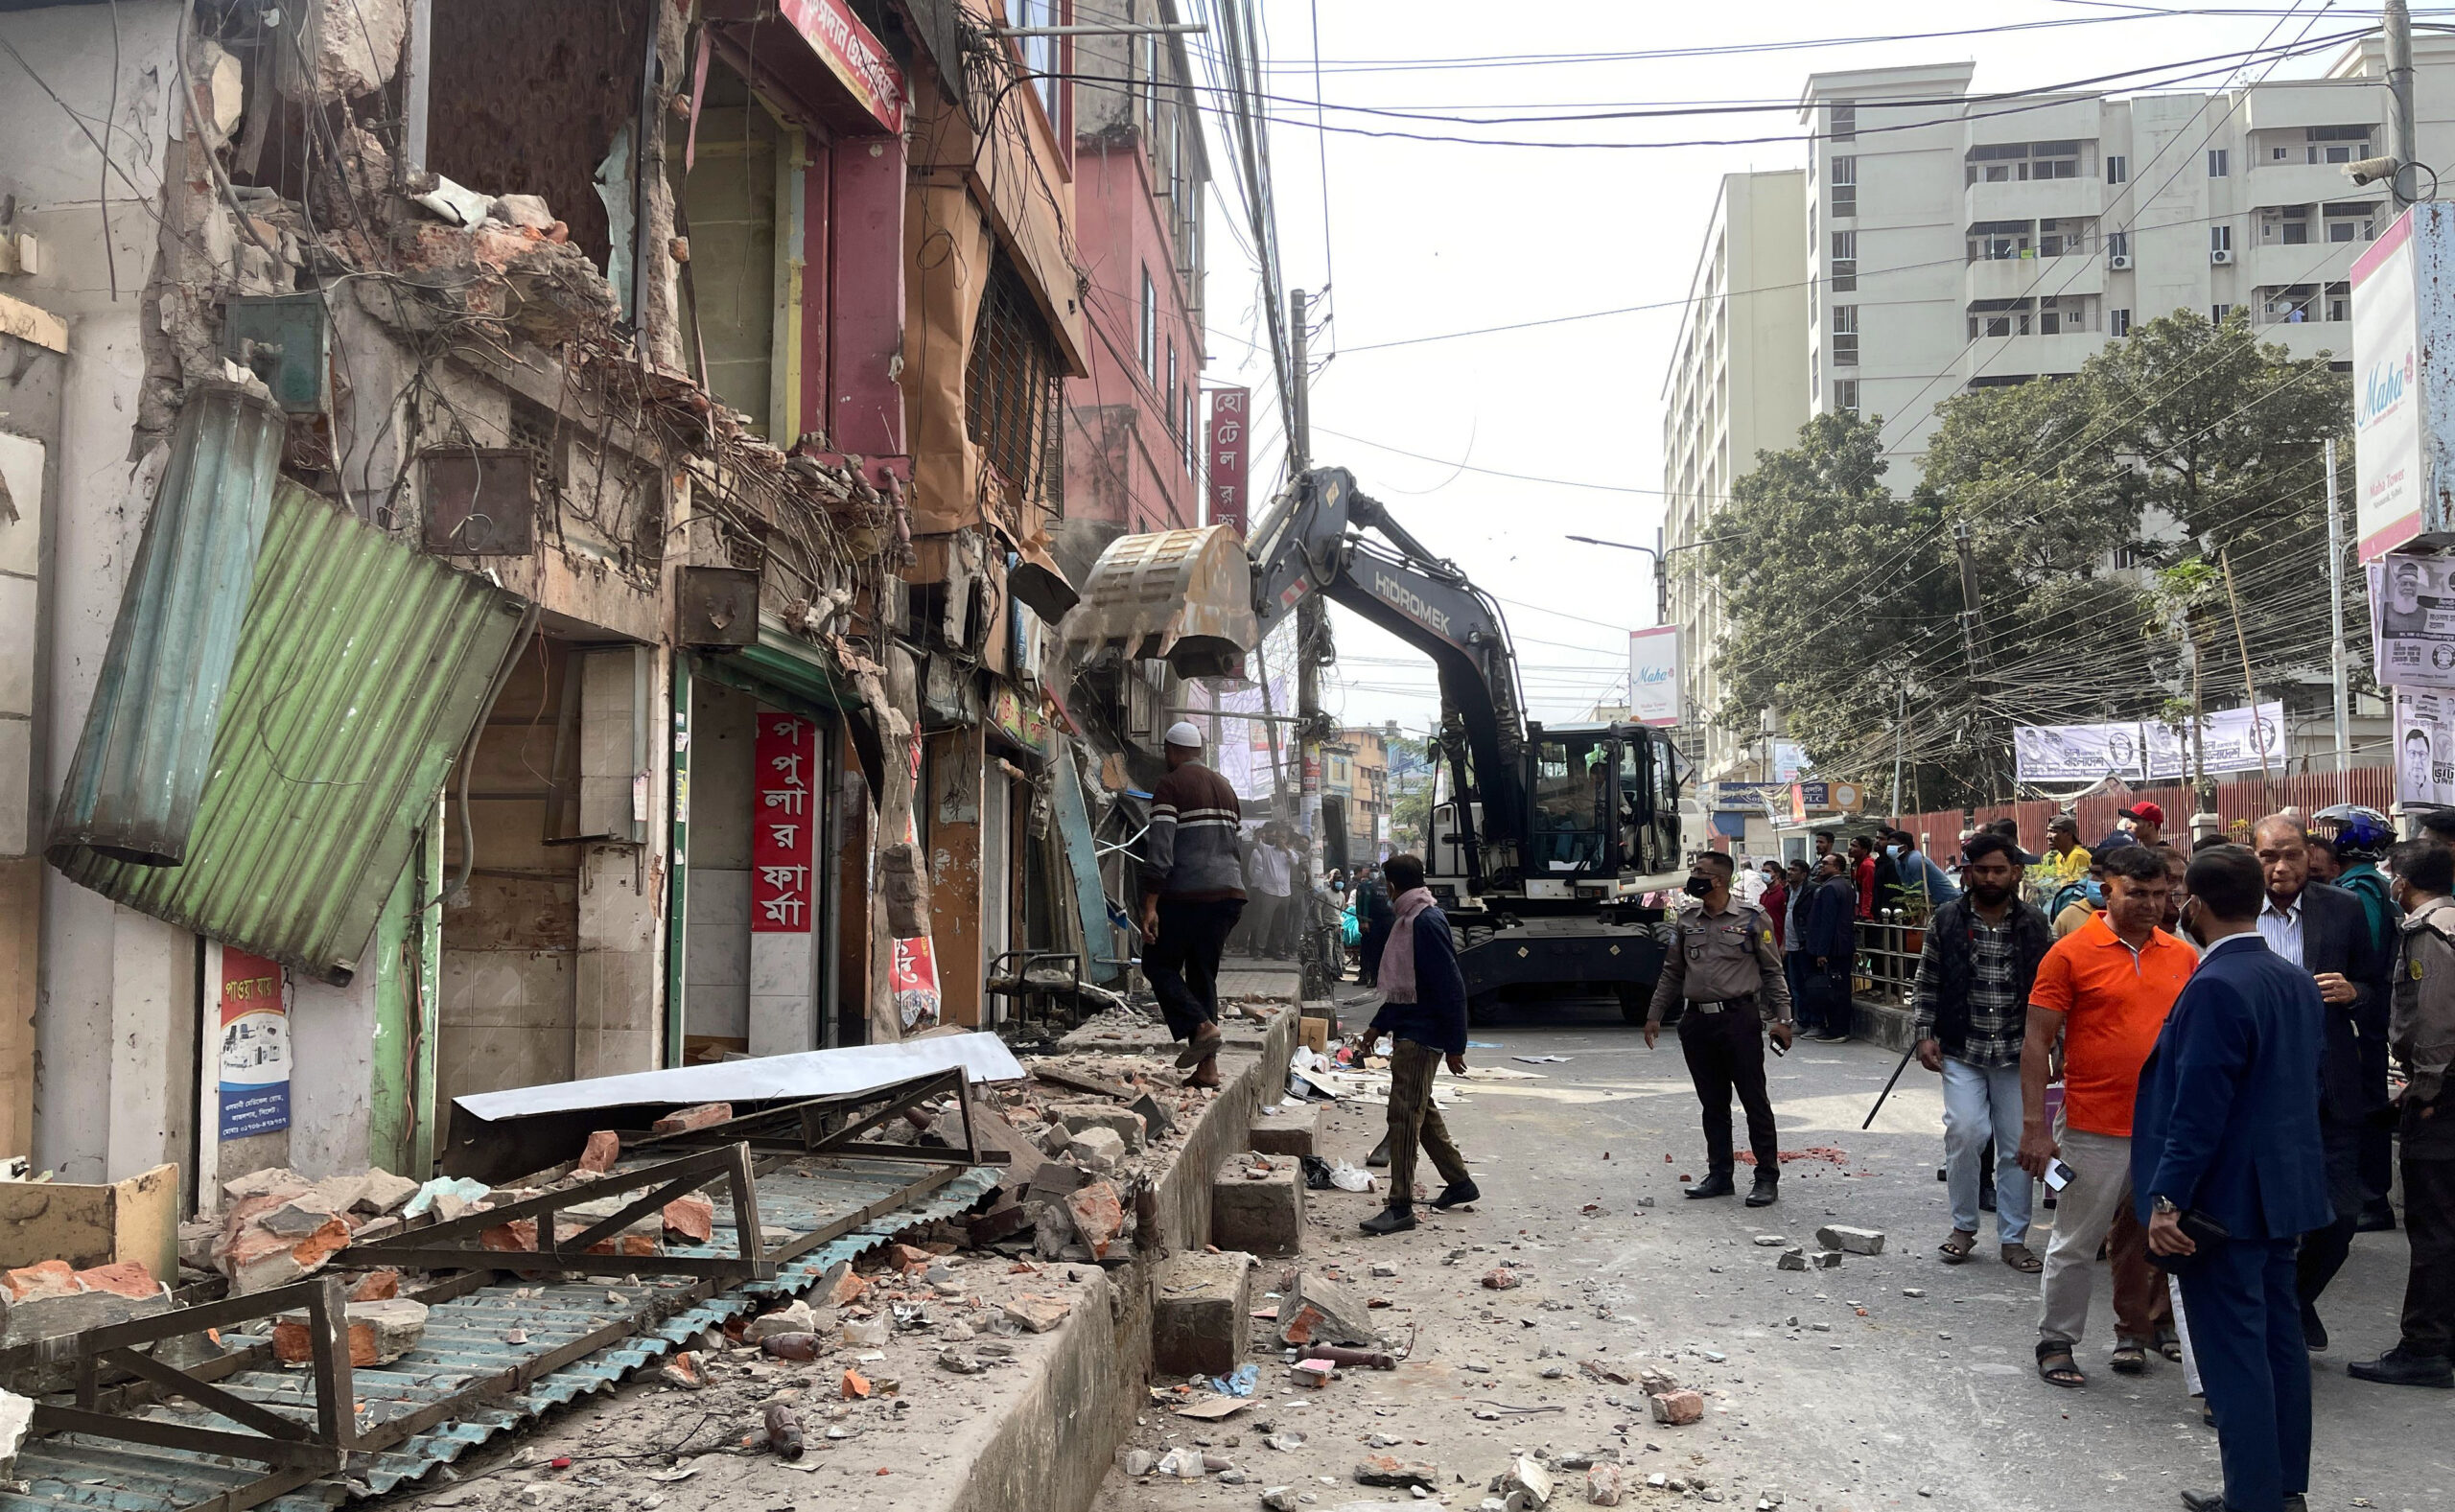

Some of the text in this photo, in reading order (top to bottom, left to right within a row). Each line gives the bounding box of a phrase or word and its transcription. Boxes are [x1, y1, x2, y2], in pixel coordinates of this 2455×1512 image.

[2357, 361, 2404, 428] Maha
[1216, 391, 1245, 472] হোটেল
[2386, 468, 2405, 489] Tower
[1632, 666, 1667, 685] Maha
[761, 719, 808, 849] পপুলার
[759, 864, 809, 926] ফার্মা
[225, 979, 254, 1003] পাওয়া
